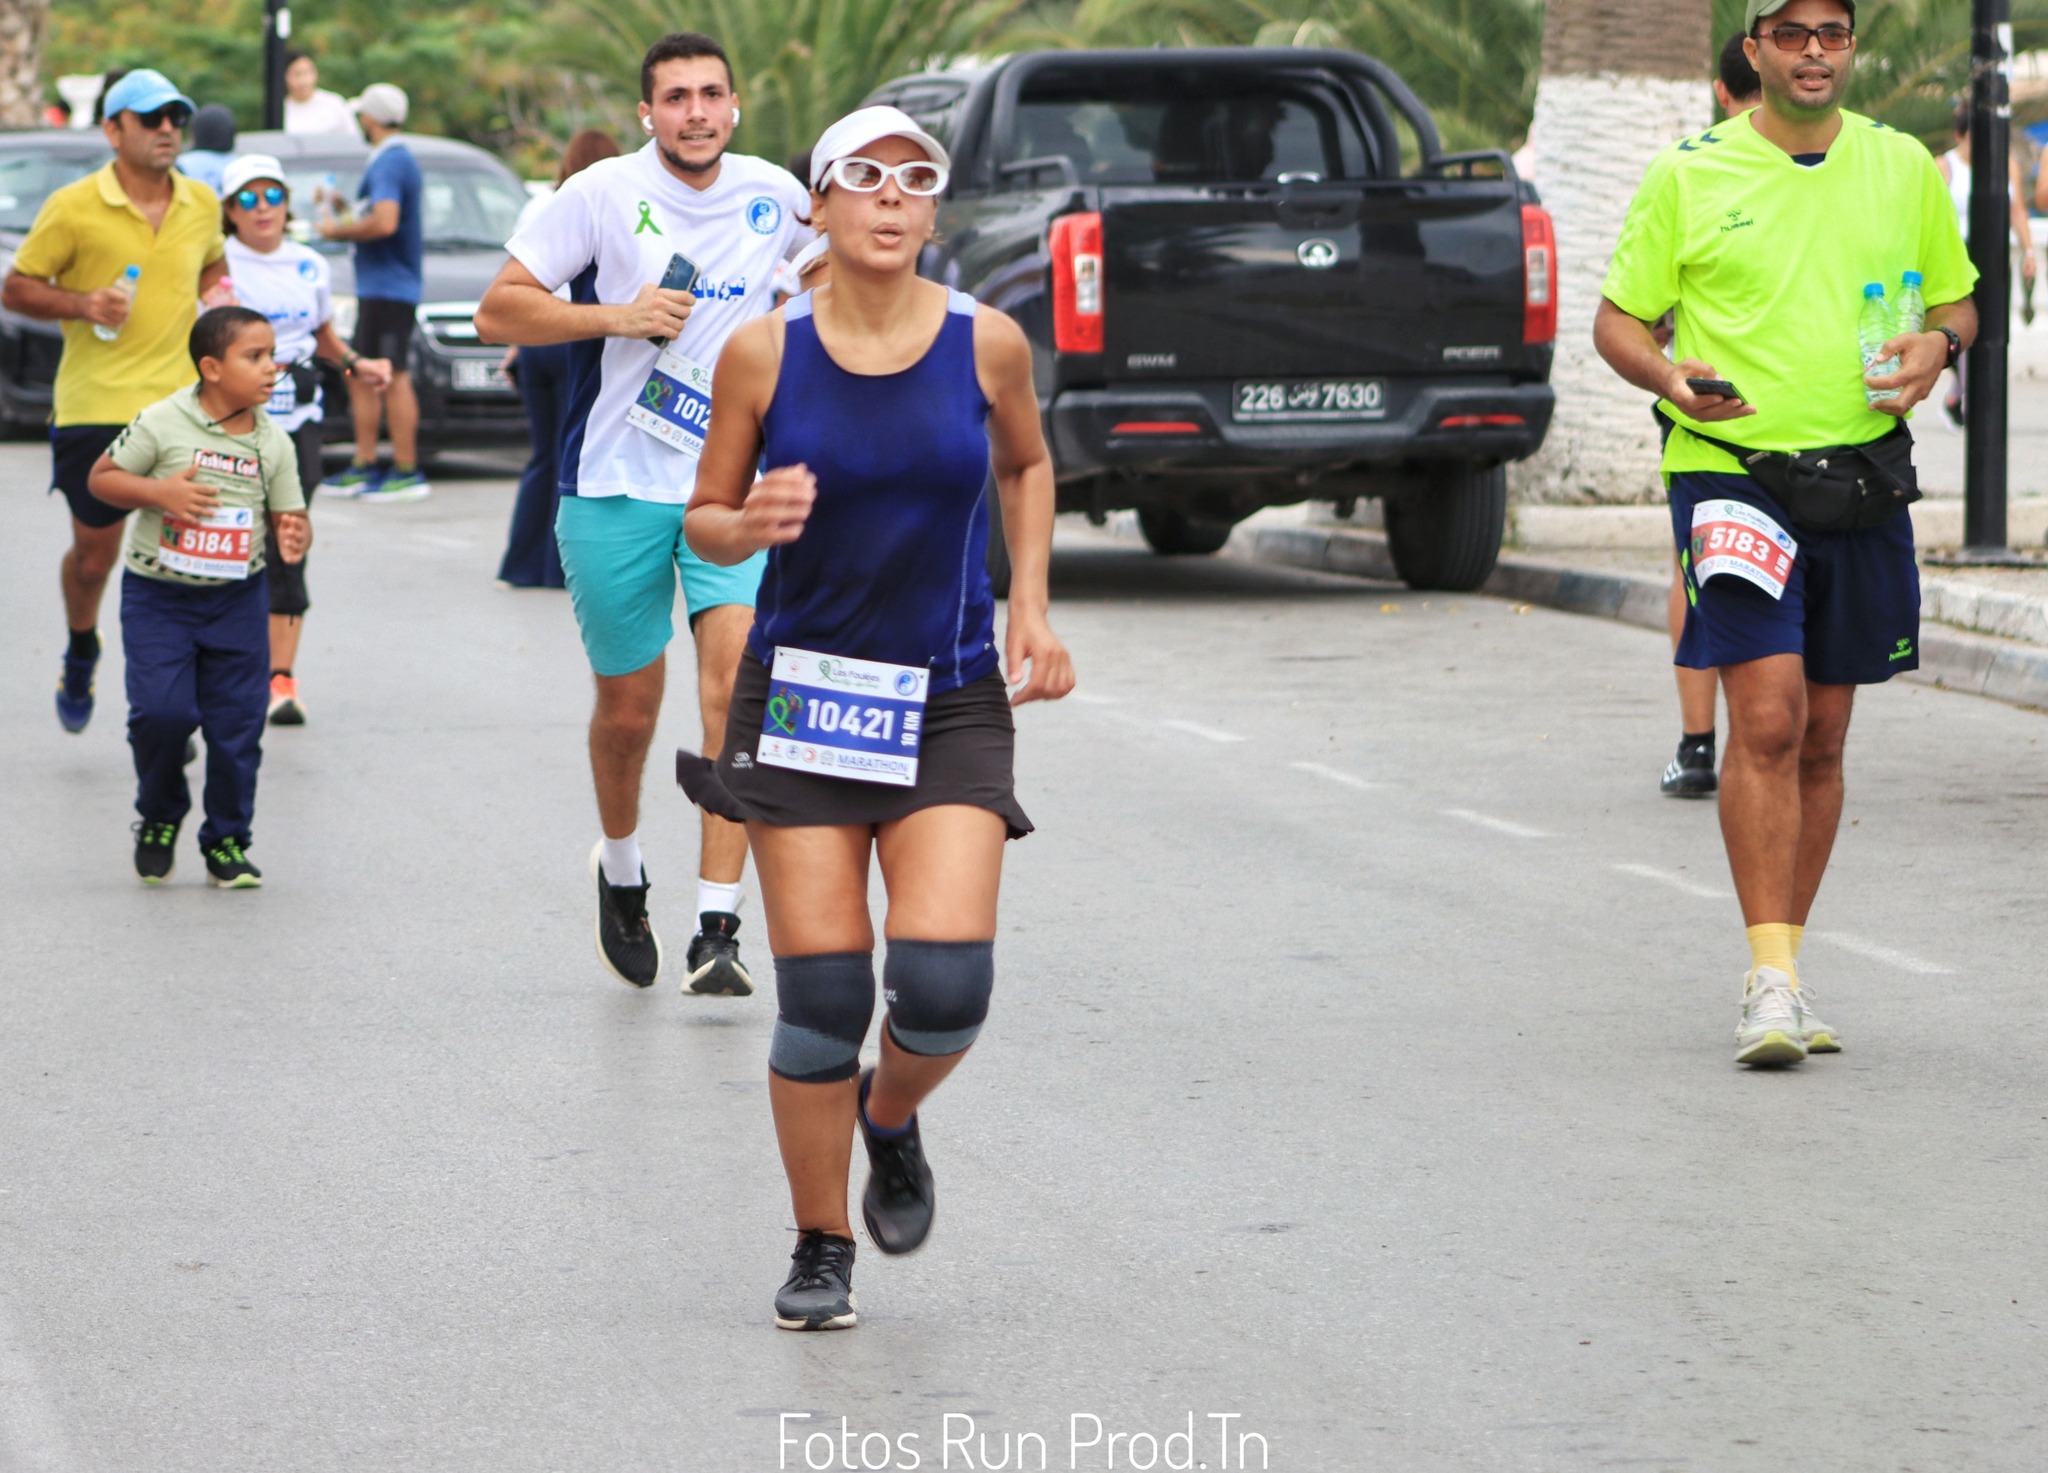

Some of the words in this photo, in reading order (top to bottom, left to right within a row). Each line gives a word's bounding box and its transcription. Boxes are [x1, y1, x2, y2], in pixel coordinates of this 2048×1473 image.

[1720, 218, 1753, 232] hummel
[718, 277, 746, 301] تبرع
[1240, 384, 1284, 411] 226
[1322, 382, 1381, 409] 7630
[195, 450, 235, 473] Fashion
[183, 528, 233, 555] 5184
[1708, 527, 1770, 562] 5183
[1730, 560, 1779, 590] MARATHON
[807, 698, 895, 740] 10421
[904, 710, 921, 731] KM
[901, 732, 918, 746] 10
[837, 754, 909, 772] MARATHON
